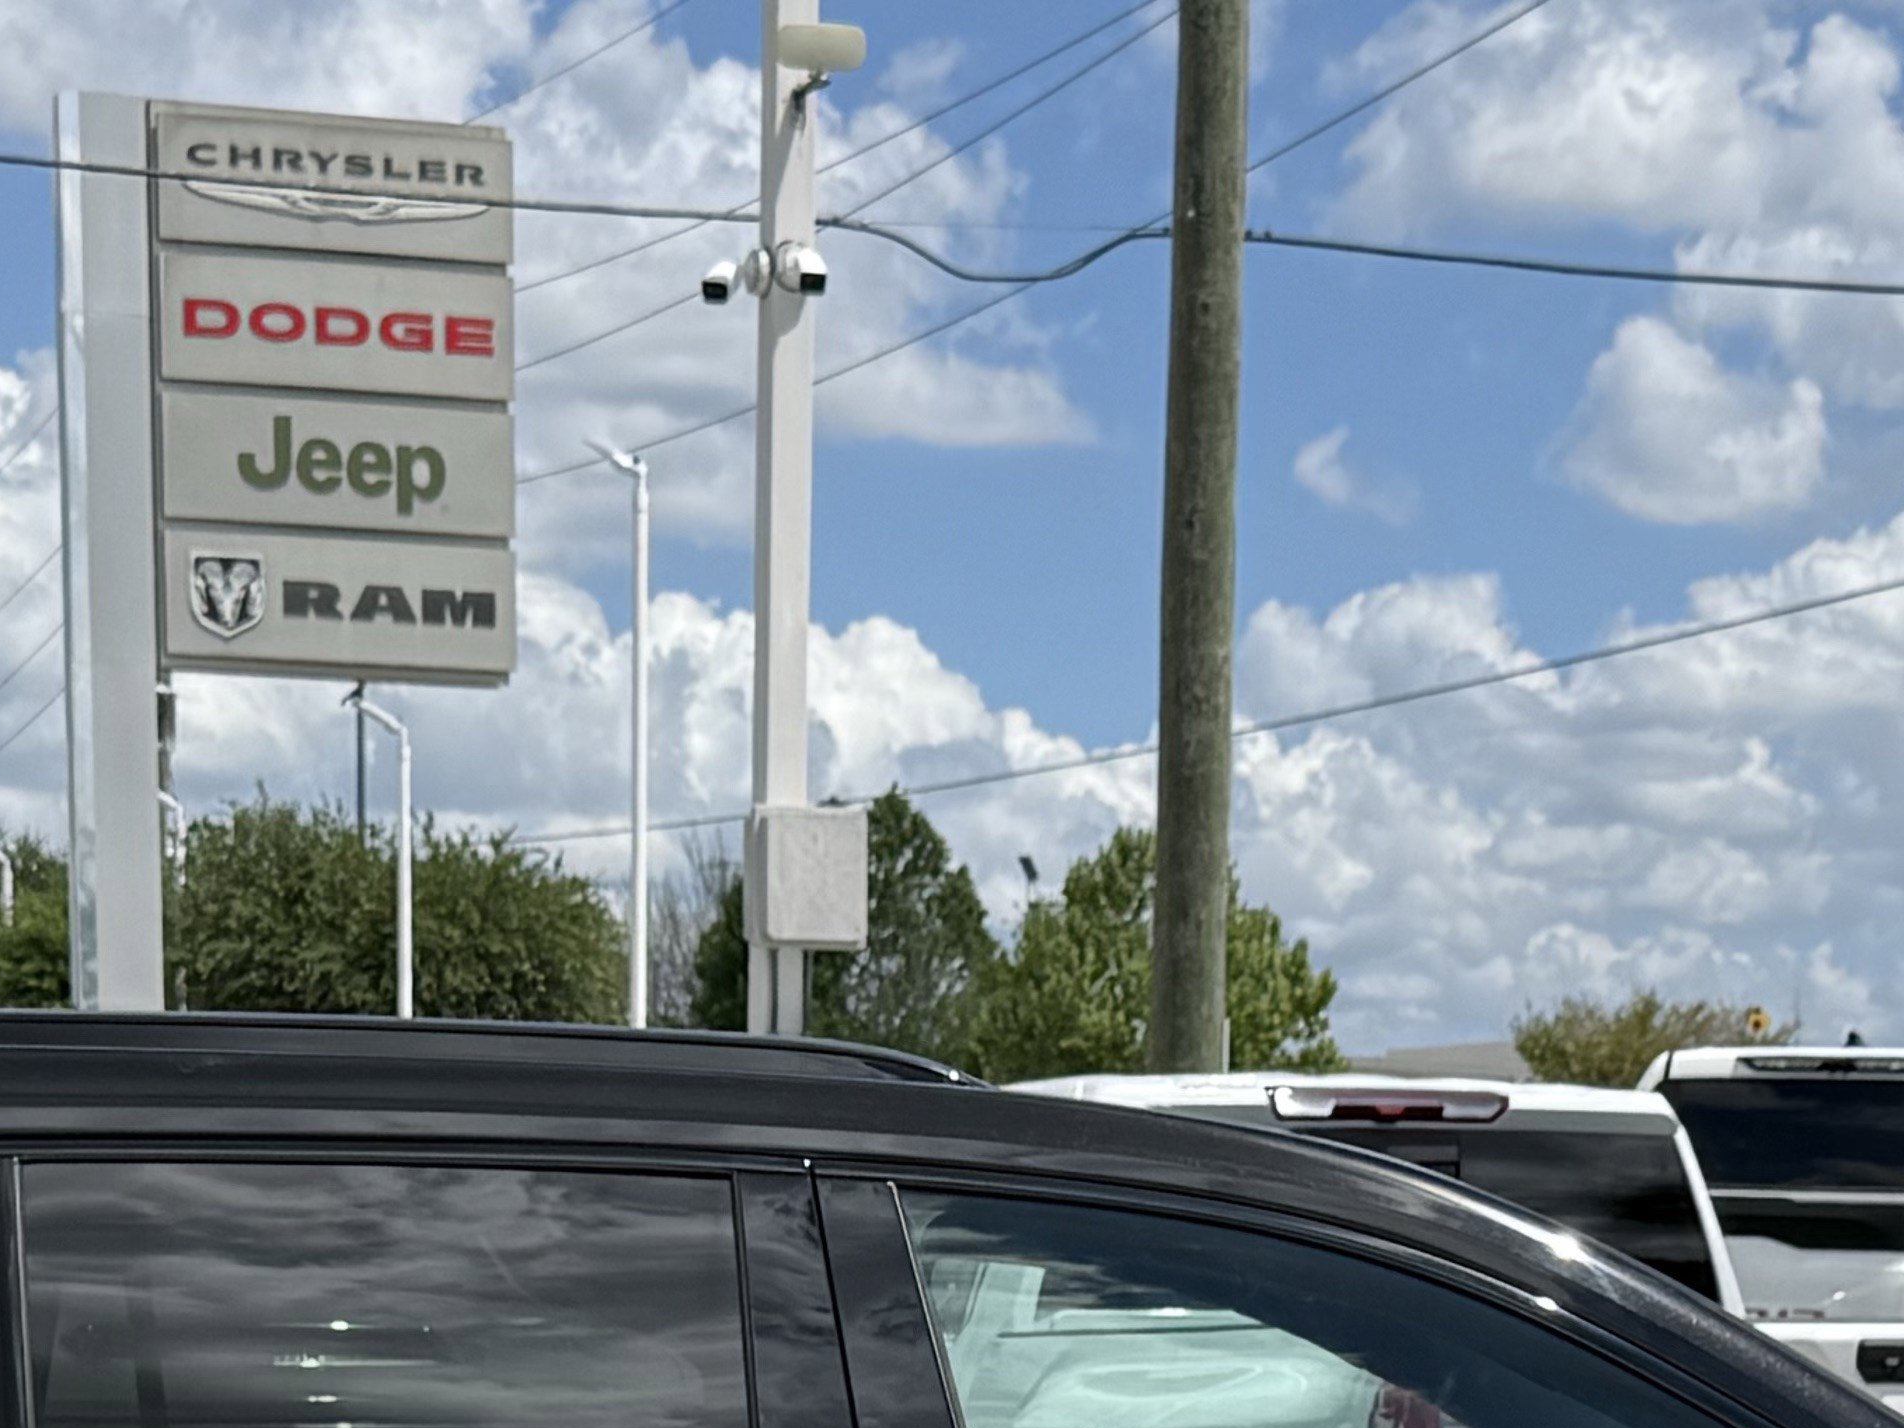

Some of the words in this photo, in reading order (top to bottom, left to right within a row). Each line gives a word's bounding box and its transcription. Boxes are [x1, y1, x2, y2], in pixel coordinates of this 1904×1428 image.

[186, 143, 485, 188] CHRYSLER
[182, 297, 495, 357] DODGE
[237, 415, 446, 517] Jeep
[282, 579, 496, 630] RAM
